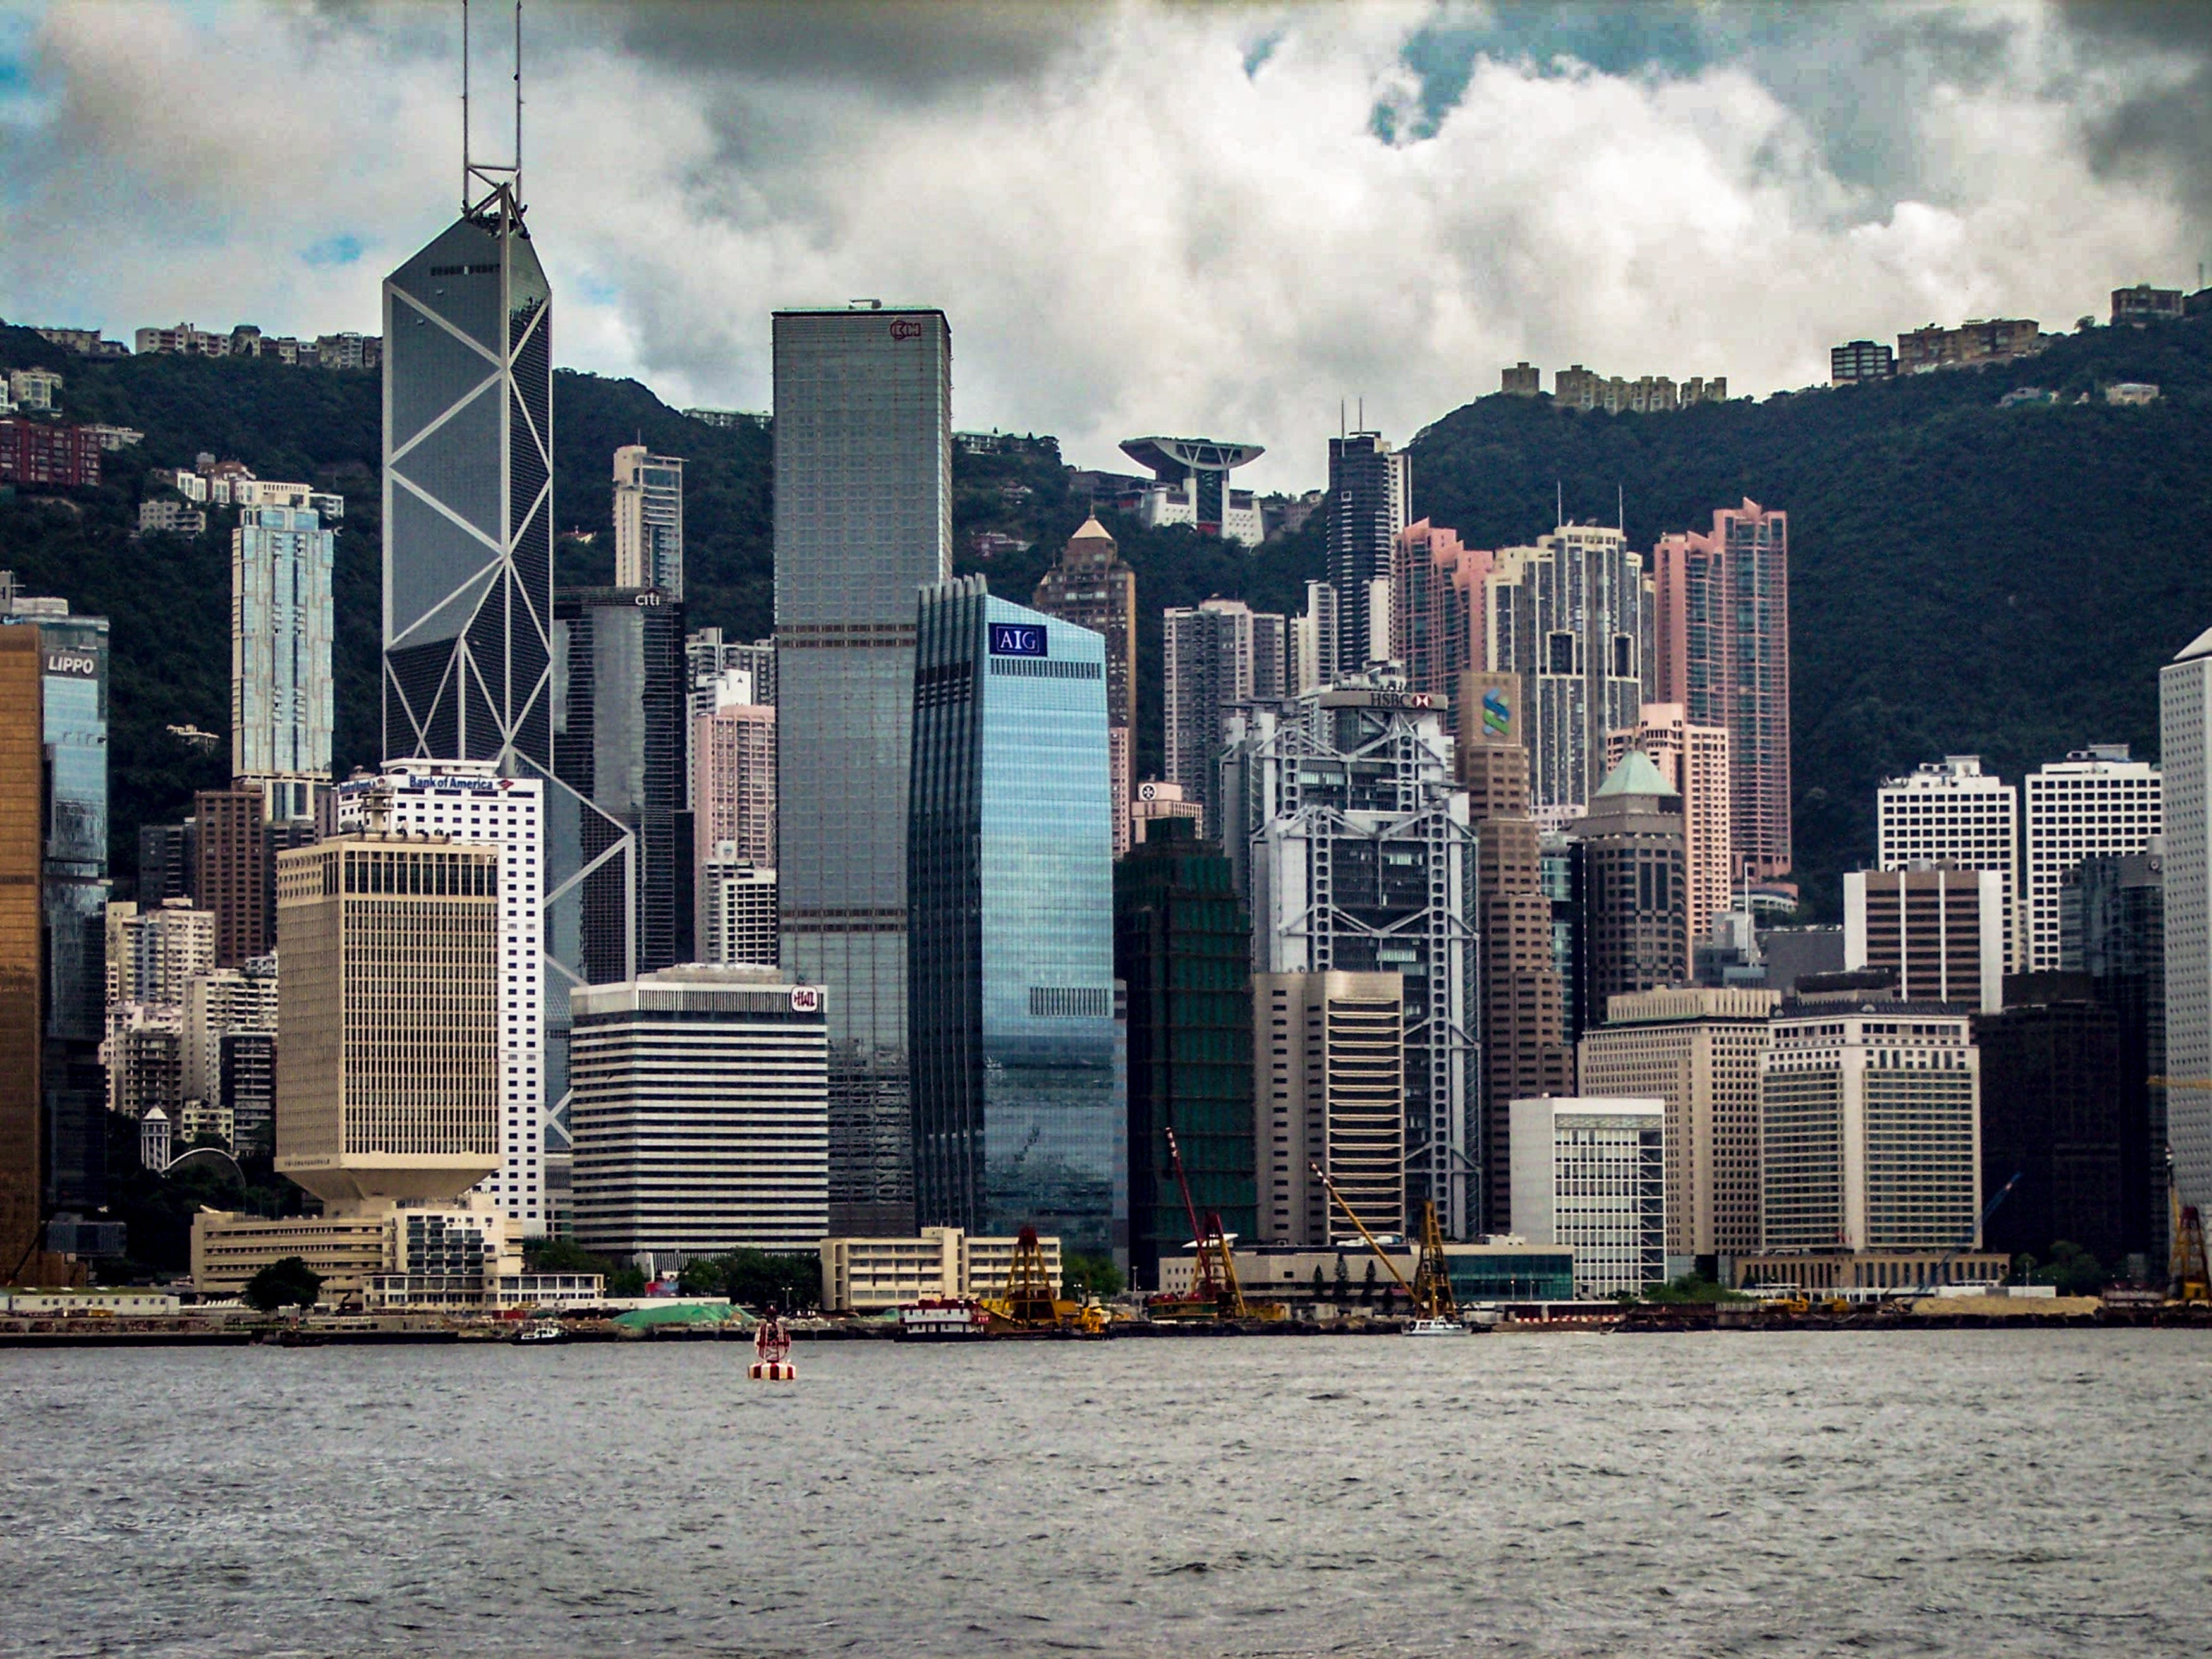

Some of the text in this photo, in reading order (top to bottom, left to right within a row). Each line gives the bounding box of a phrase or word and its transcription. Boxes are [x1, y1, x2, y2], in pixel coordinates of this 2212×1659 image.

[1000, 630, 1036, 650] AIG
[48, 656, 94, 675] LIPPO
[1370, 693, 1411, 707] HSBC
[410, 775, 493, 789] Bank of America
